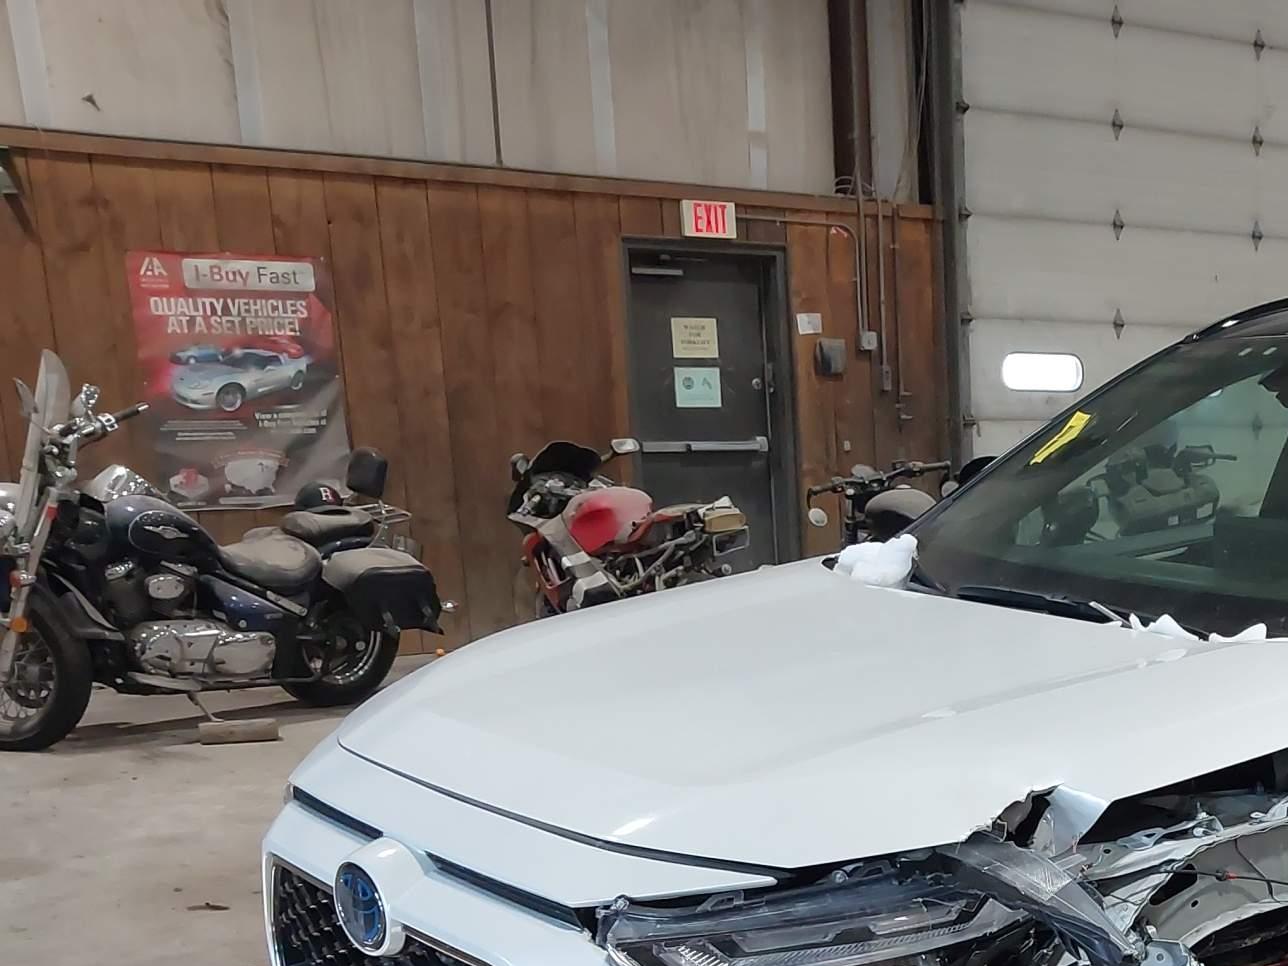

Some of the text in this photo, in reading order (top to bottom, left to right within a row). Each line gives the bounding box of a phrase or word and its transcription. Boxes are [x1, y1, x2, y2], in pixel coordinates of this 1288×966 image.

[693, 203, 727, 234] EXIT
[194, 264, 250, 286] I-Buy
[256, 266, 299, 285] Fast
[149, 296, 308, 318] QUALITY VEHICLES
[167, 316, 301, 336] AT A SET PRICE!
